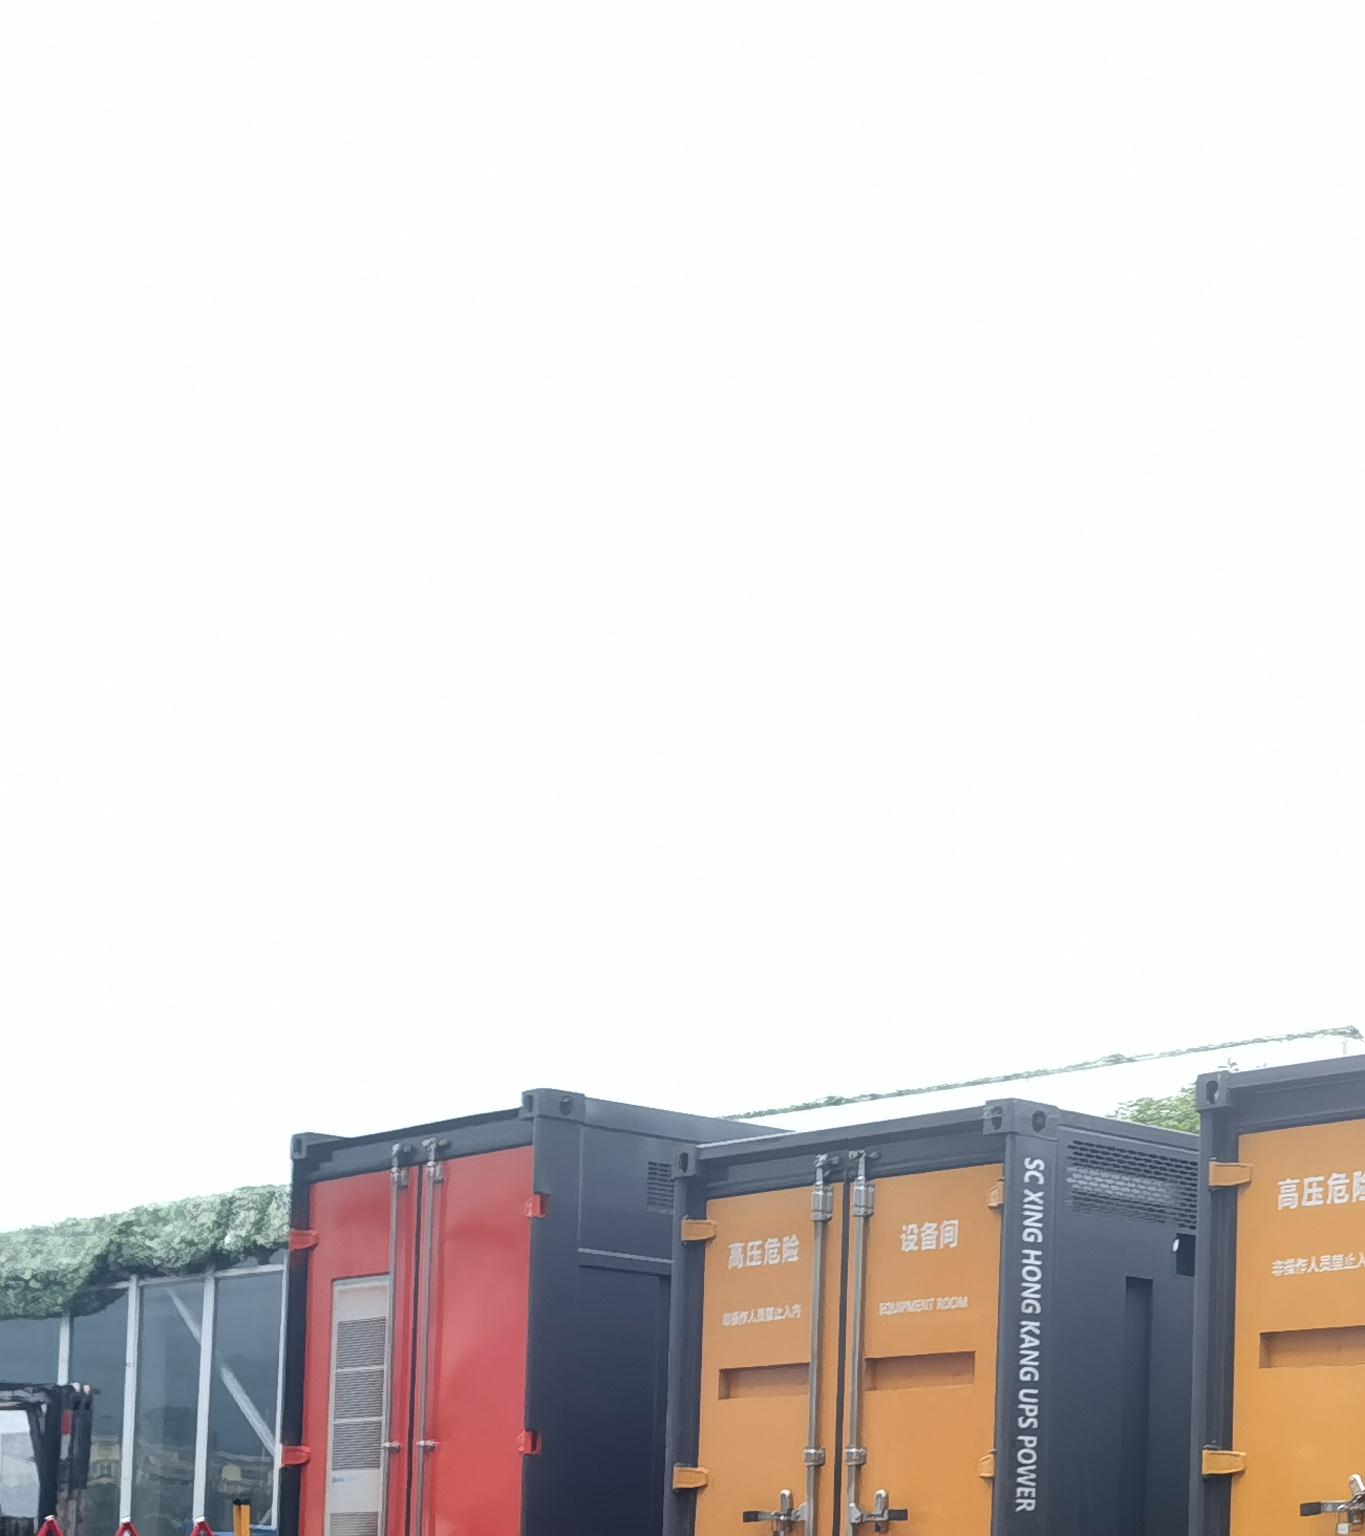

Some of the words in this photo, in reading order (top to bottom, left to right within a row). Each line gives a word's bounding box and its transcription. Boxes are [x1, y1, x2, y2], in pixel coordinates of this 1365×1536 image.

[1023, 1157, 1045, 1185] SC
[901, 1219, 960, 1253] 设备间
[1021, 1188, 1044, 1244] XING
[727, 1234, 801, 1270] 高压危险
[1020, 1249, 1043, 1314] HONG
[1018, 1320, 1041, 1382] KANG
[1017, 1388, 1039, 1429] UPS
[1015, 1435, 1038, 1512] POWER
